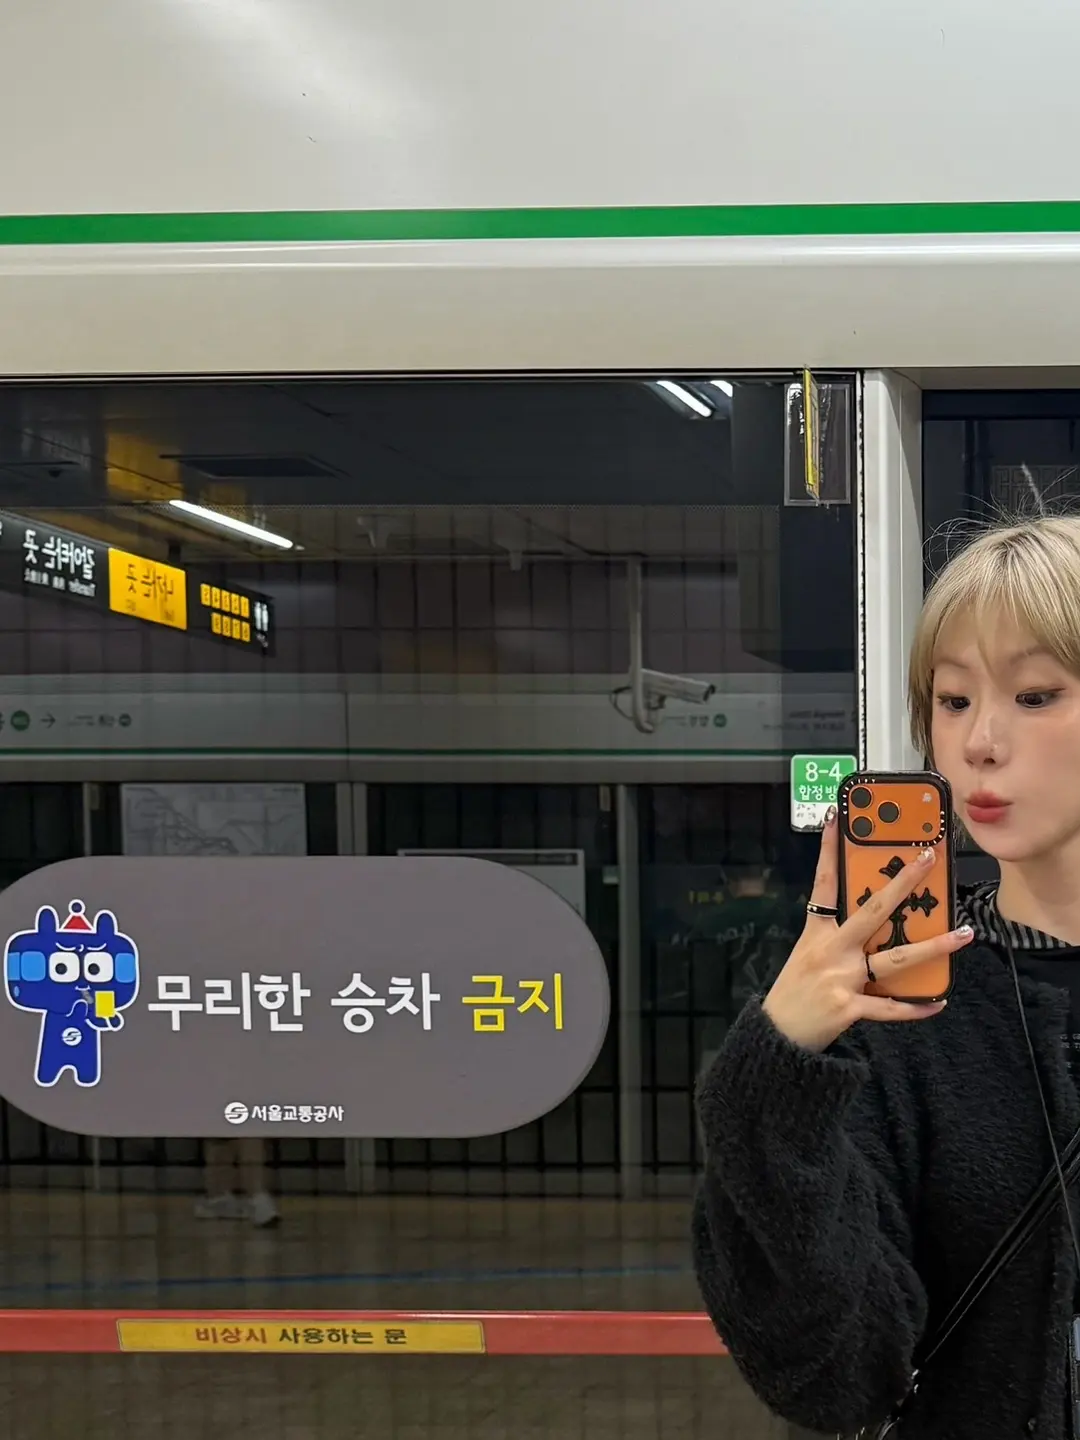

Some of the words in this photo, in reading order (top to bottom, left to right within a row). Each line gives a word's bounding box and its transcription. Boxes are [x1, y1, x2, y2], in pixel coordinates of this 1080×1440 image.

[805, 761, 843, 782] 8-4
[798, 784, 823, 802] 합정
[825, 784, 838, 802] 방
[147, 972, 311, 1032] 무리한
[330, 972, 441, 1033] 승차
[462, 973, 564, 1031] 금지
[251, 1103, 345, 1123] 서울교통공사
[195, 1327, 267, 1344] 비상시
[279, 1327, 374, 1345] 사용하는
[384, 1328, 408, 1345] 문
